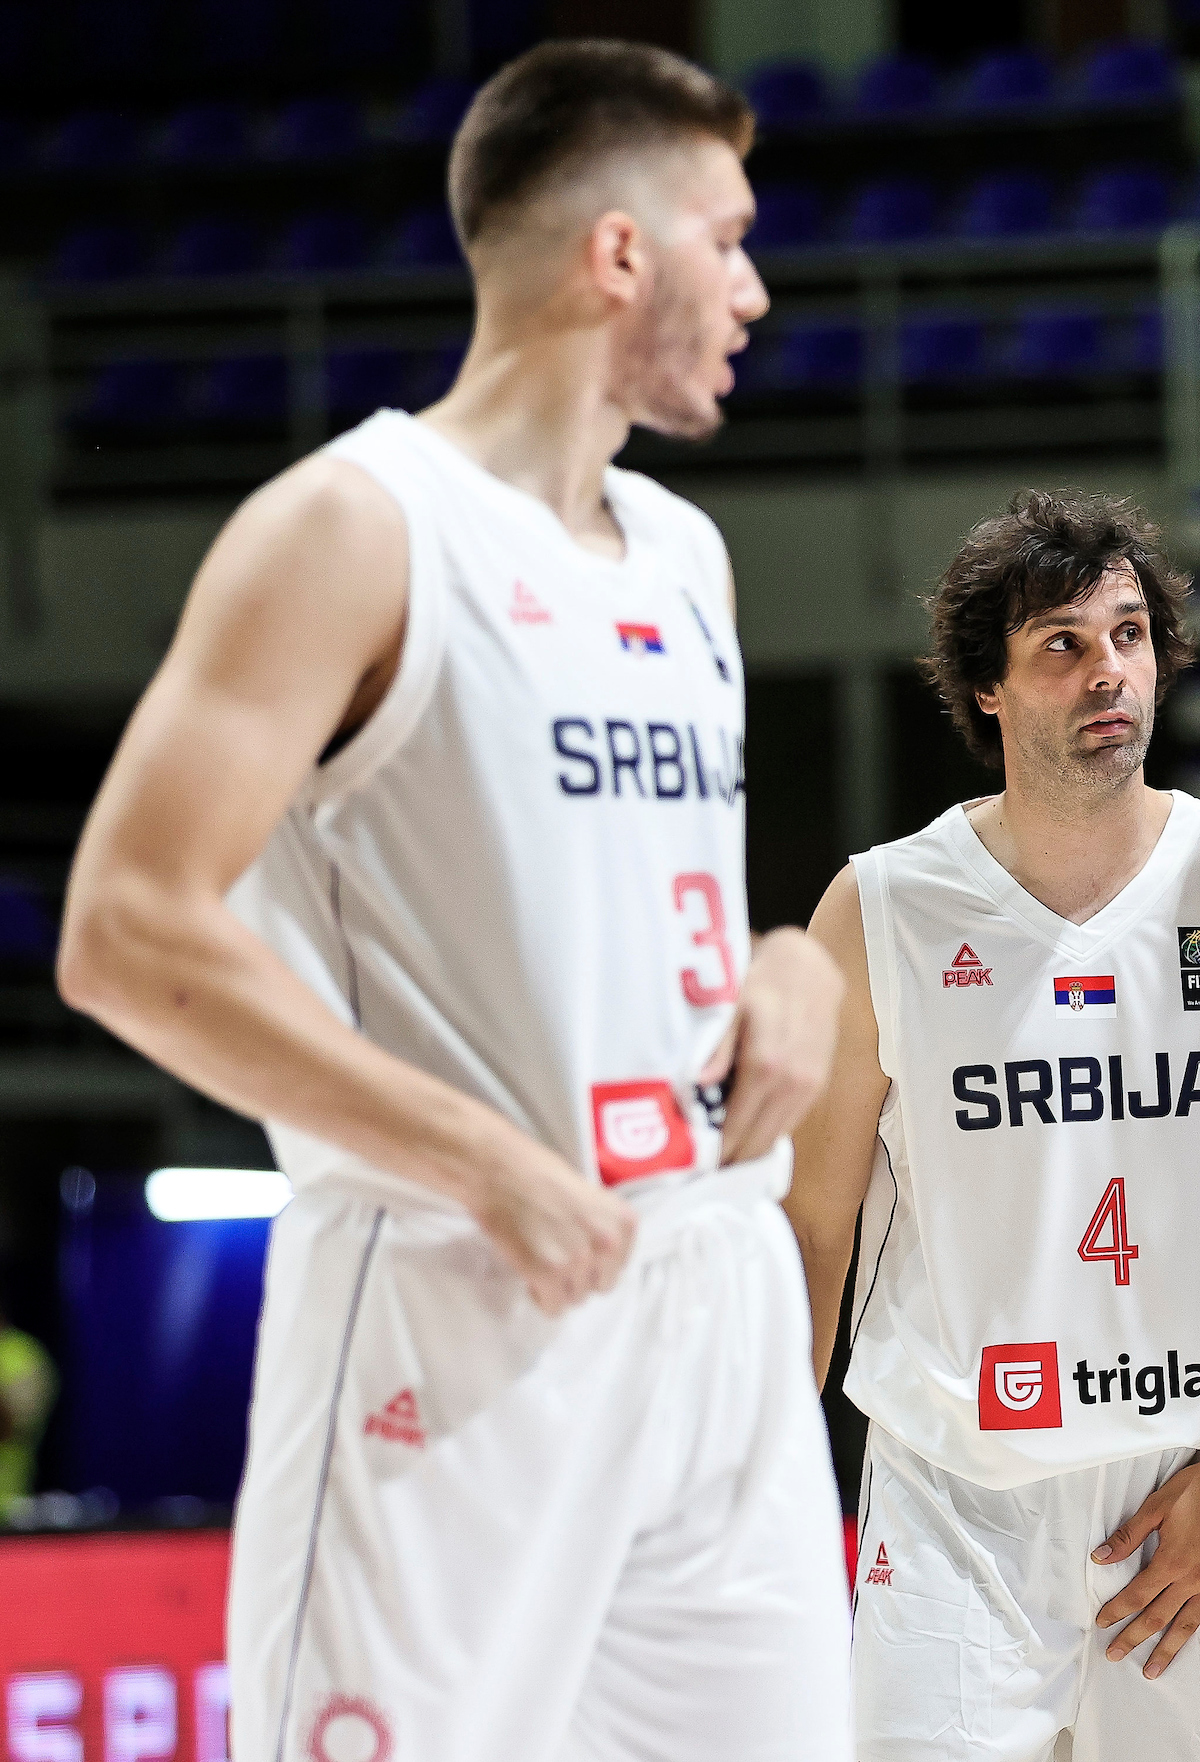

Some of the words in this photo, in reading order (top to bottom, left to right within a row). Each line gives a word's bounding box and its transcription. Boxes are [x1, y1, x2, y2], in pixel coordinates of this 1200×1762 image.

[671, 870, 740, 1009] 3
[942, 968, 994, 988] PEAK
[1077, 1177, 1139, 1286] 4
